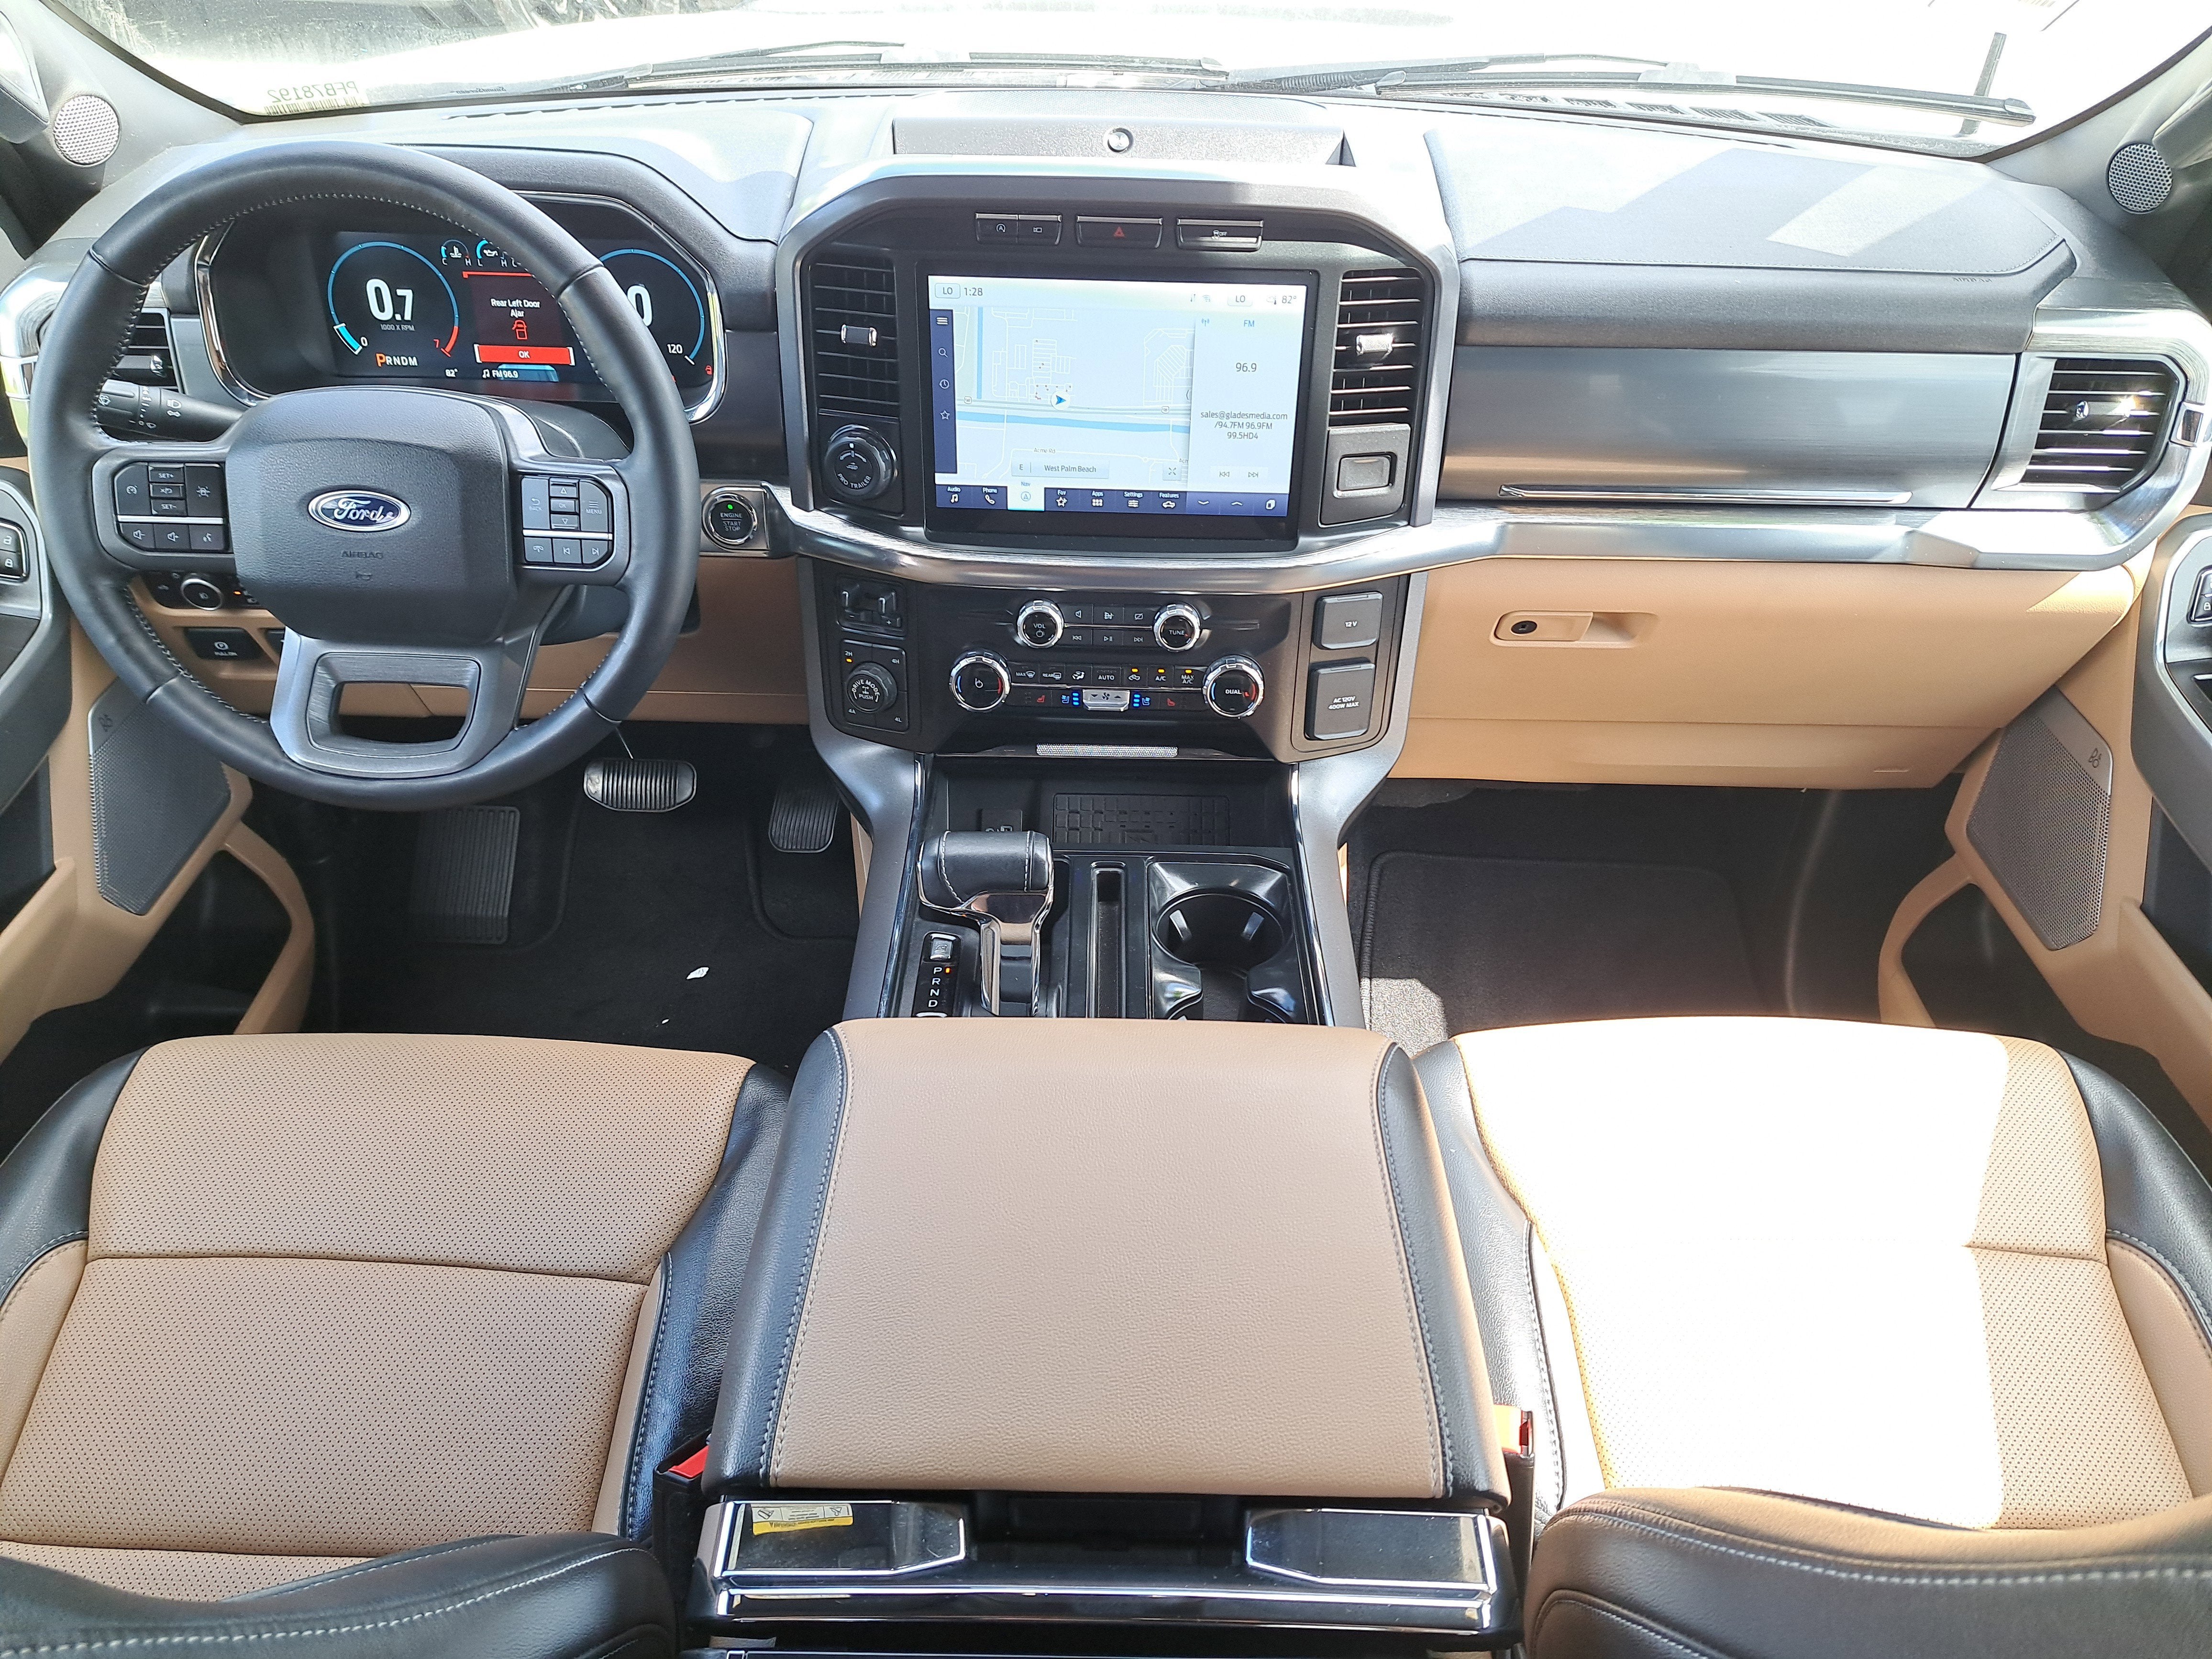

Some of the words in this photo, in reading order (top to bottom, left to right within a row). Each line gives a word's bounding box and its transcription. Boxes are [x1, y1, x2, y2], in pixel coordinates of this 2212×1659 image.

[964, 288, 983, 296] 1:28
[366, 279, 414, 321] 0.7
[490, 299, 507, 307] Rear
[508, 299, 523, 307] Left
[523, 299, 540, 308] Door
[510, 309, 525, 318] Ajar
[360, 337, 368, 346] 0
[433, 339, 440, 348] 7
[667, 344, 683, 353] 120
[518, 351, 531, 359] OK
[1236, 363, 1257, 372] 96.9
[1200, 411, 1288, 421] sales@gladesmedia.com
[837, 474, 849, 485] PRO
[850, 476, 872, 489] TRAILER
[334, 498, 392, 522] Ford
[852, 679, 865, 693] DRIVE
[865, 679, 880, 696] MODE
